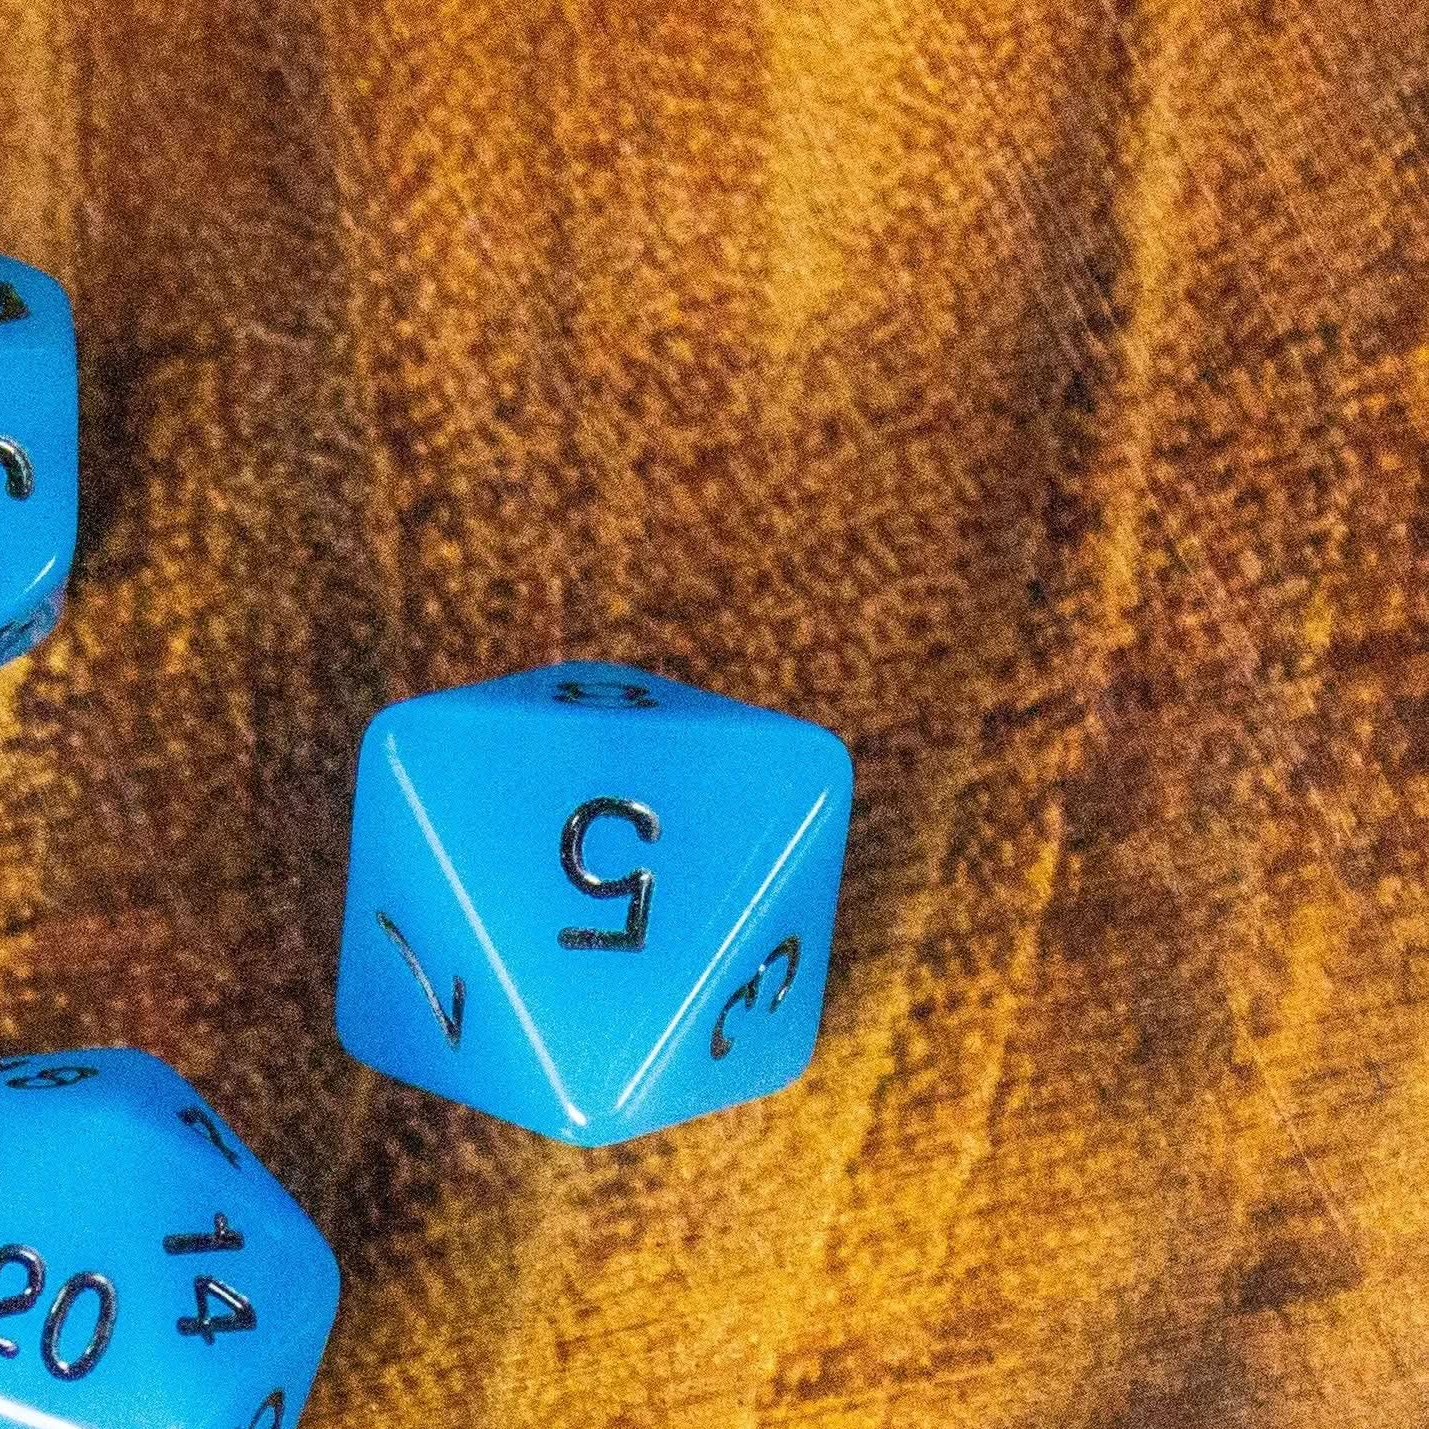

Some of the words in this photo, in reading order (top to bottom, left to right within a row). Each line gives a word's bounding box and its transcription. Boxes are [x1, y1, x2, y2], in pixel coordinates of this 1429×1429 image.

[556, 794, 661, 953] 5
[710, 935, 802, 1060] 3
[162, 1212, 257, 1345] 14
